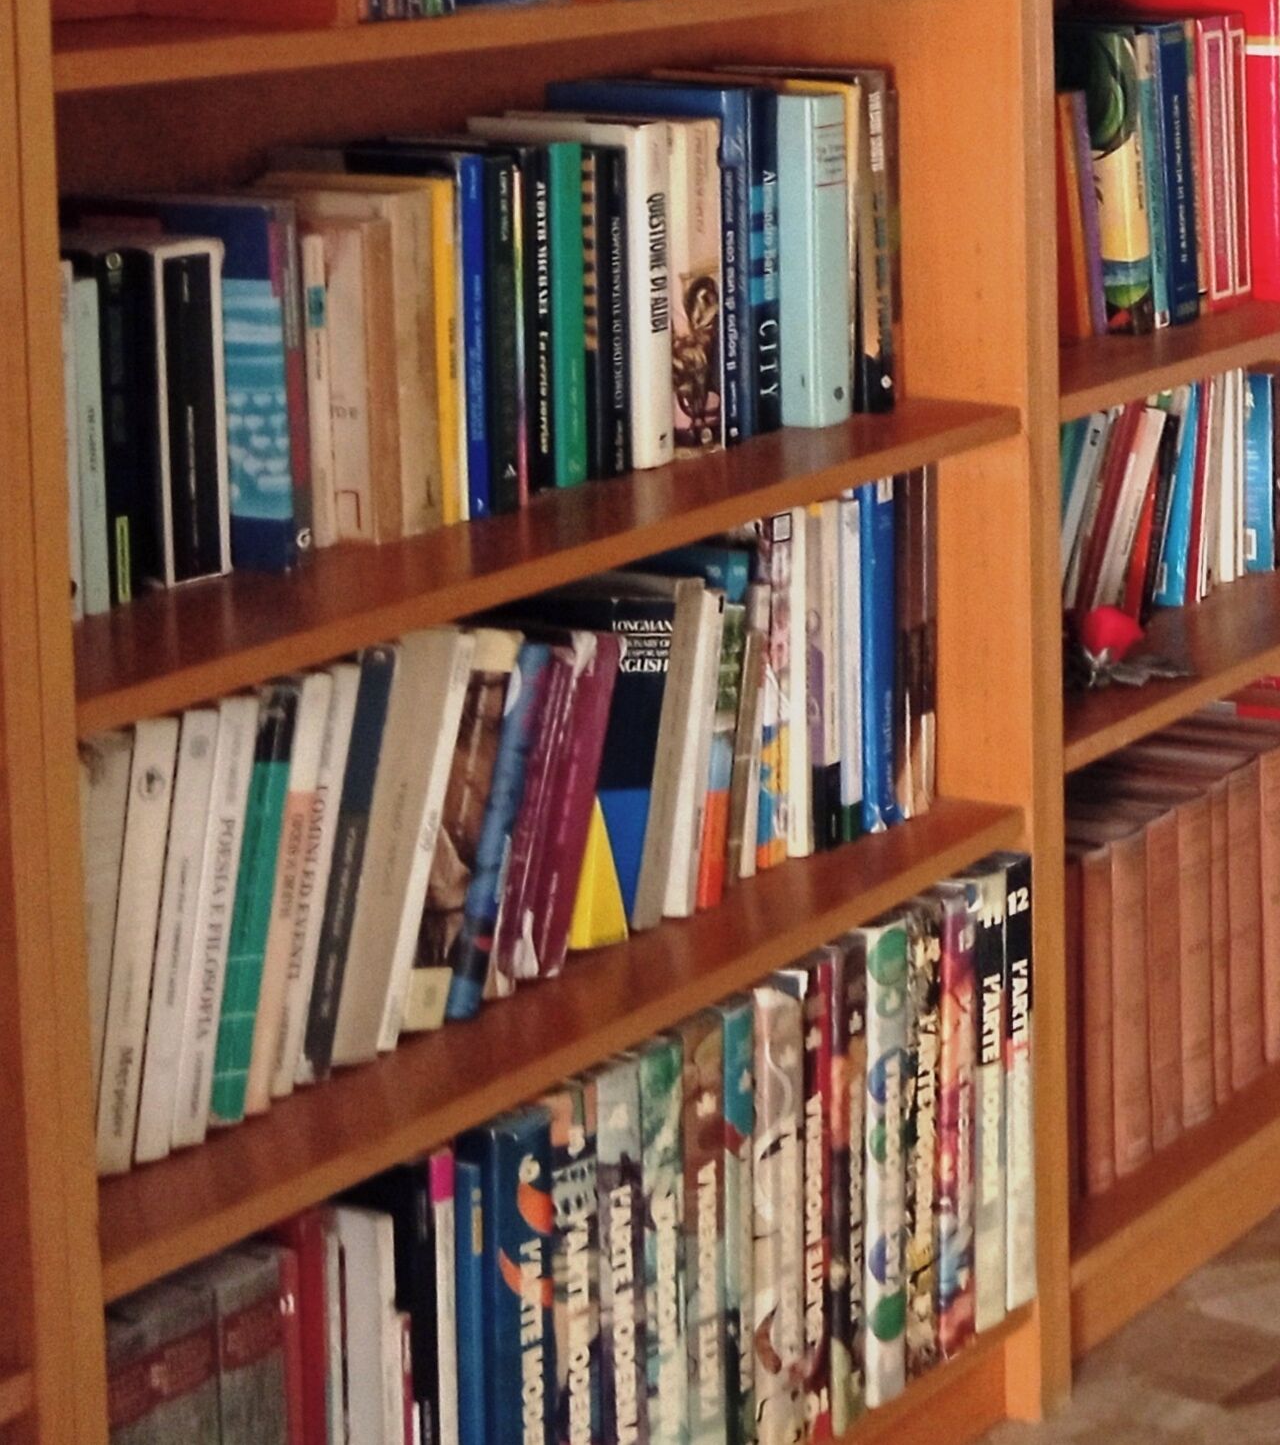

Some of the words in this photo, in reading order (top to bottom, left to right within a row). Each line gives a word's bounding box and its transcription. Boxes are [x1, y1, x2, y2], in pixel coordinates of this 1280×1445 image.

[536, 181, 547, 241] JUDITH
[646, 193, 667, 272] QUESTIONE
[762, 170, 775, 246] Alessandro
[611, 216, 622, 314] TUTANKHAMON
[726, 230, 735, 263] cosa
[537, 245, 548, 316] MICHAEL
[650, 276, 667, 292] DI
[762, 249, 774, 301] Baricco
[650, 297, 669, 333] ALIBI
[725, 297, 736, 311] di
[727, 314, 738, 358] sogno
[759, 319, 778, 400] CITY
[612, 620, 673, 633] LONGMAN
[211, 818, 236, 896] POESIA
[209, 903, 227, 917] E
[1008, 886, 1030, 915] 12
[195, 923, 223, 1041] FILOSOFIA
[982, 973, 1001, 1064] L'ARTE
